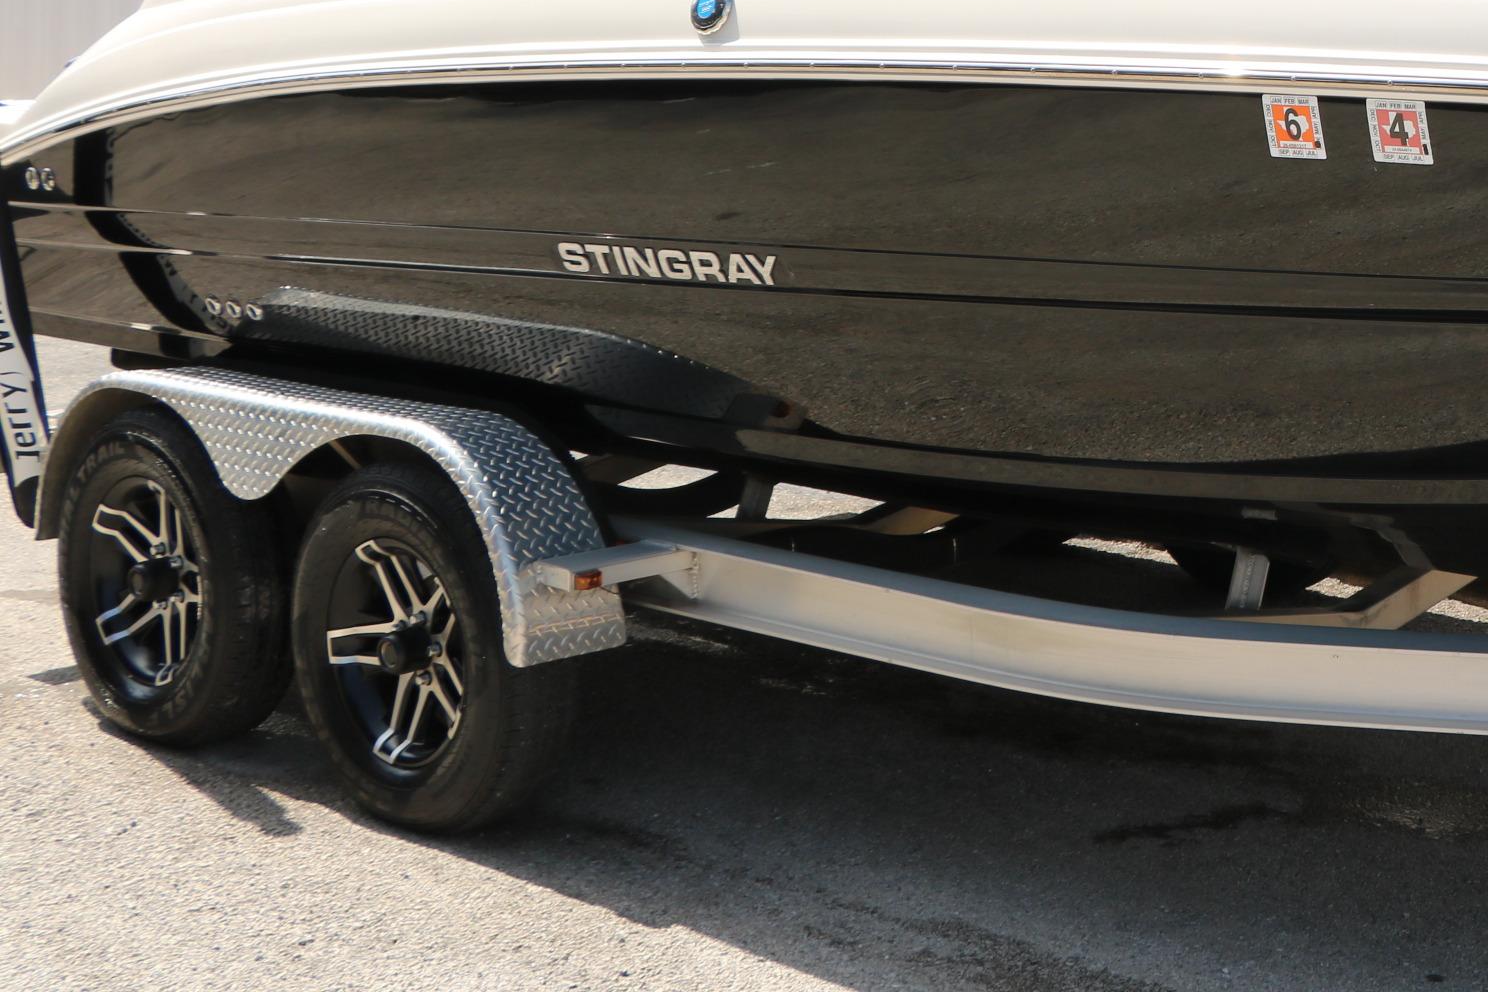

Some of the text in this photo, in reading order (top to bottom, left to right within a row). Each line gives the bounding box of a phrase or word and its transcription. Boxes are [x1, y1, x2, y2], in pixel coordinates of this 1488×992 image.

[1284, 107, 1302, 141] 6
[1389, 112, 1409, 146] 4
[557, 241, 777, 286] STINGRAY
